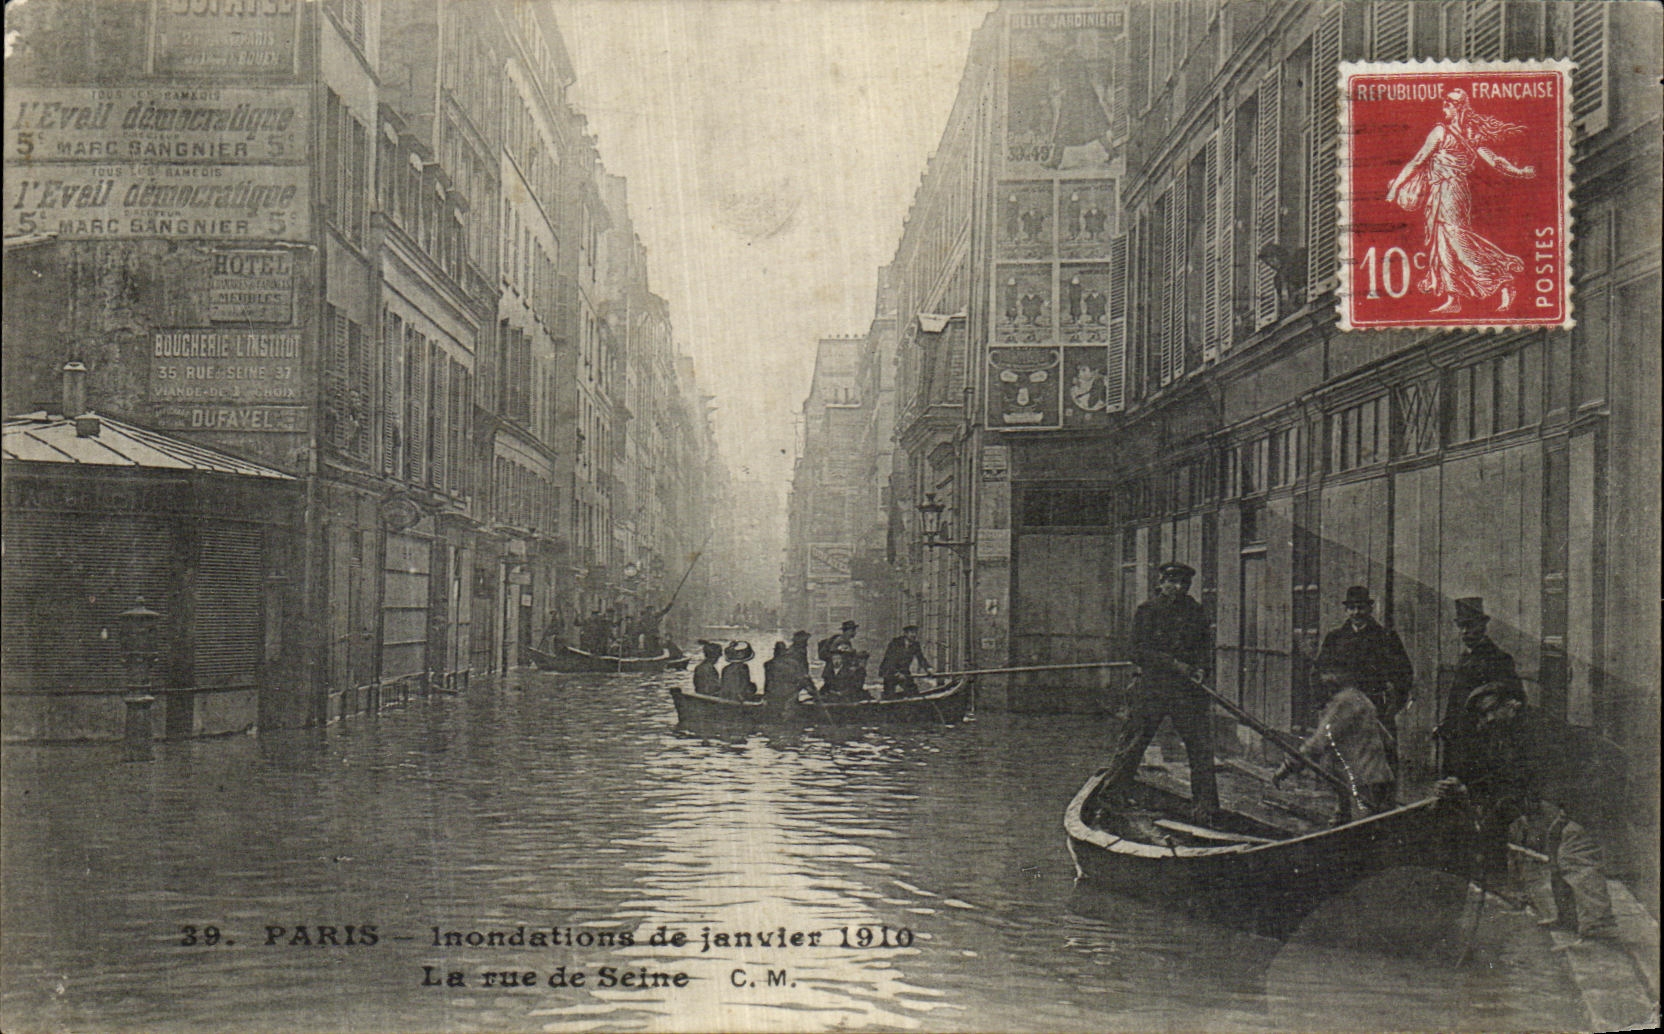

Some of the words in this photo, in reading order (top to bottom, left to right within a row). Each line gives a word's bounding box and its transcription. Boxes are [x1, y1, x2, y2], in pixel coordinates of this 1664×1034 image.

[1357, 83, 1444, 102] REPUBLIQUE
[1472, 81, 1553, 100] FRANÇAISE
[57, 141, 118, 155] MARC
[129, 141, 248, 157] SANGNIER
[58, 219, 119, 234] MARC
[130, 219, 249, 234] SANGNIER
[213, 254, 289, 275] HOTEL
[1535, 226, 1554, 308] POSTES
[155, 333, 228, 357] BOUCHERIE
[158, 366, 177, 379] 35
[186, 366, 214, 379] RUE
[227, 366, 266, 380] SEINE
[275, 366, 292, 380] 37
[192, 409, 273, 428] DUFAYEL
